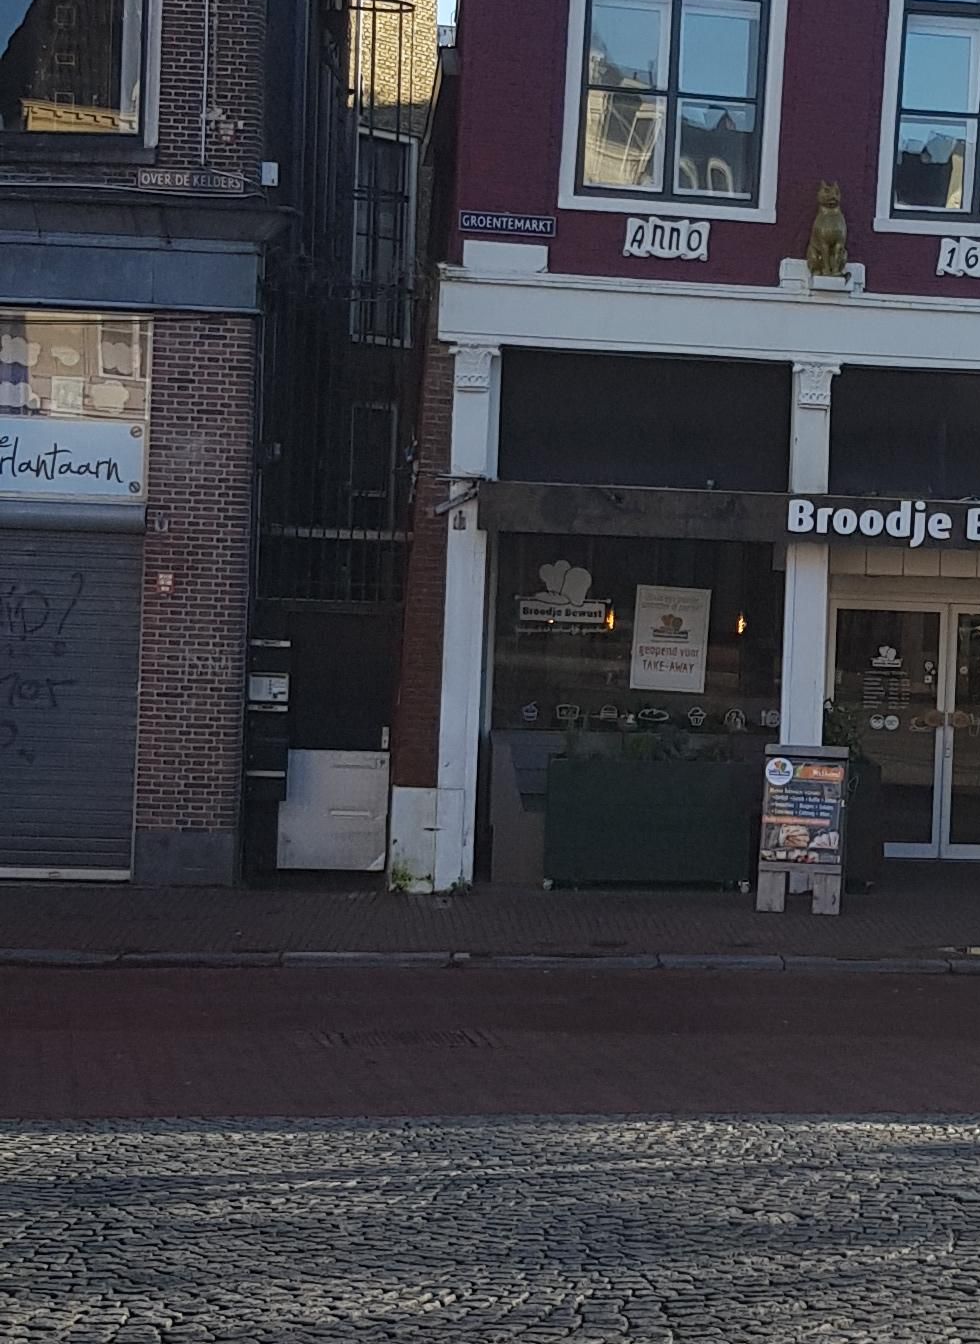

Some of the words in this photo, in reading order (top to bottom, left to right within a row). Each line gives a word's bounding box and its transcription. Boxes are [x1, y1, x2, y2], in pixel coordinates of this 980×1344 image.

[141, 172, 172, 185] OVER
[175, 174, 191, 187] DE
[193, 175, 240, 188] KELDERS
[462, 214, 553, 233] GROENTEMARKT
[787, 499, 951, 548] Broodje
[522, 607, 562, 618] Broodje
[564, 607, 602, 619] Bewust
[642, 659, 695, 674] TAKE-AWAY
